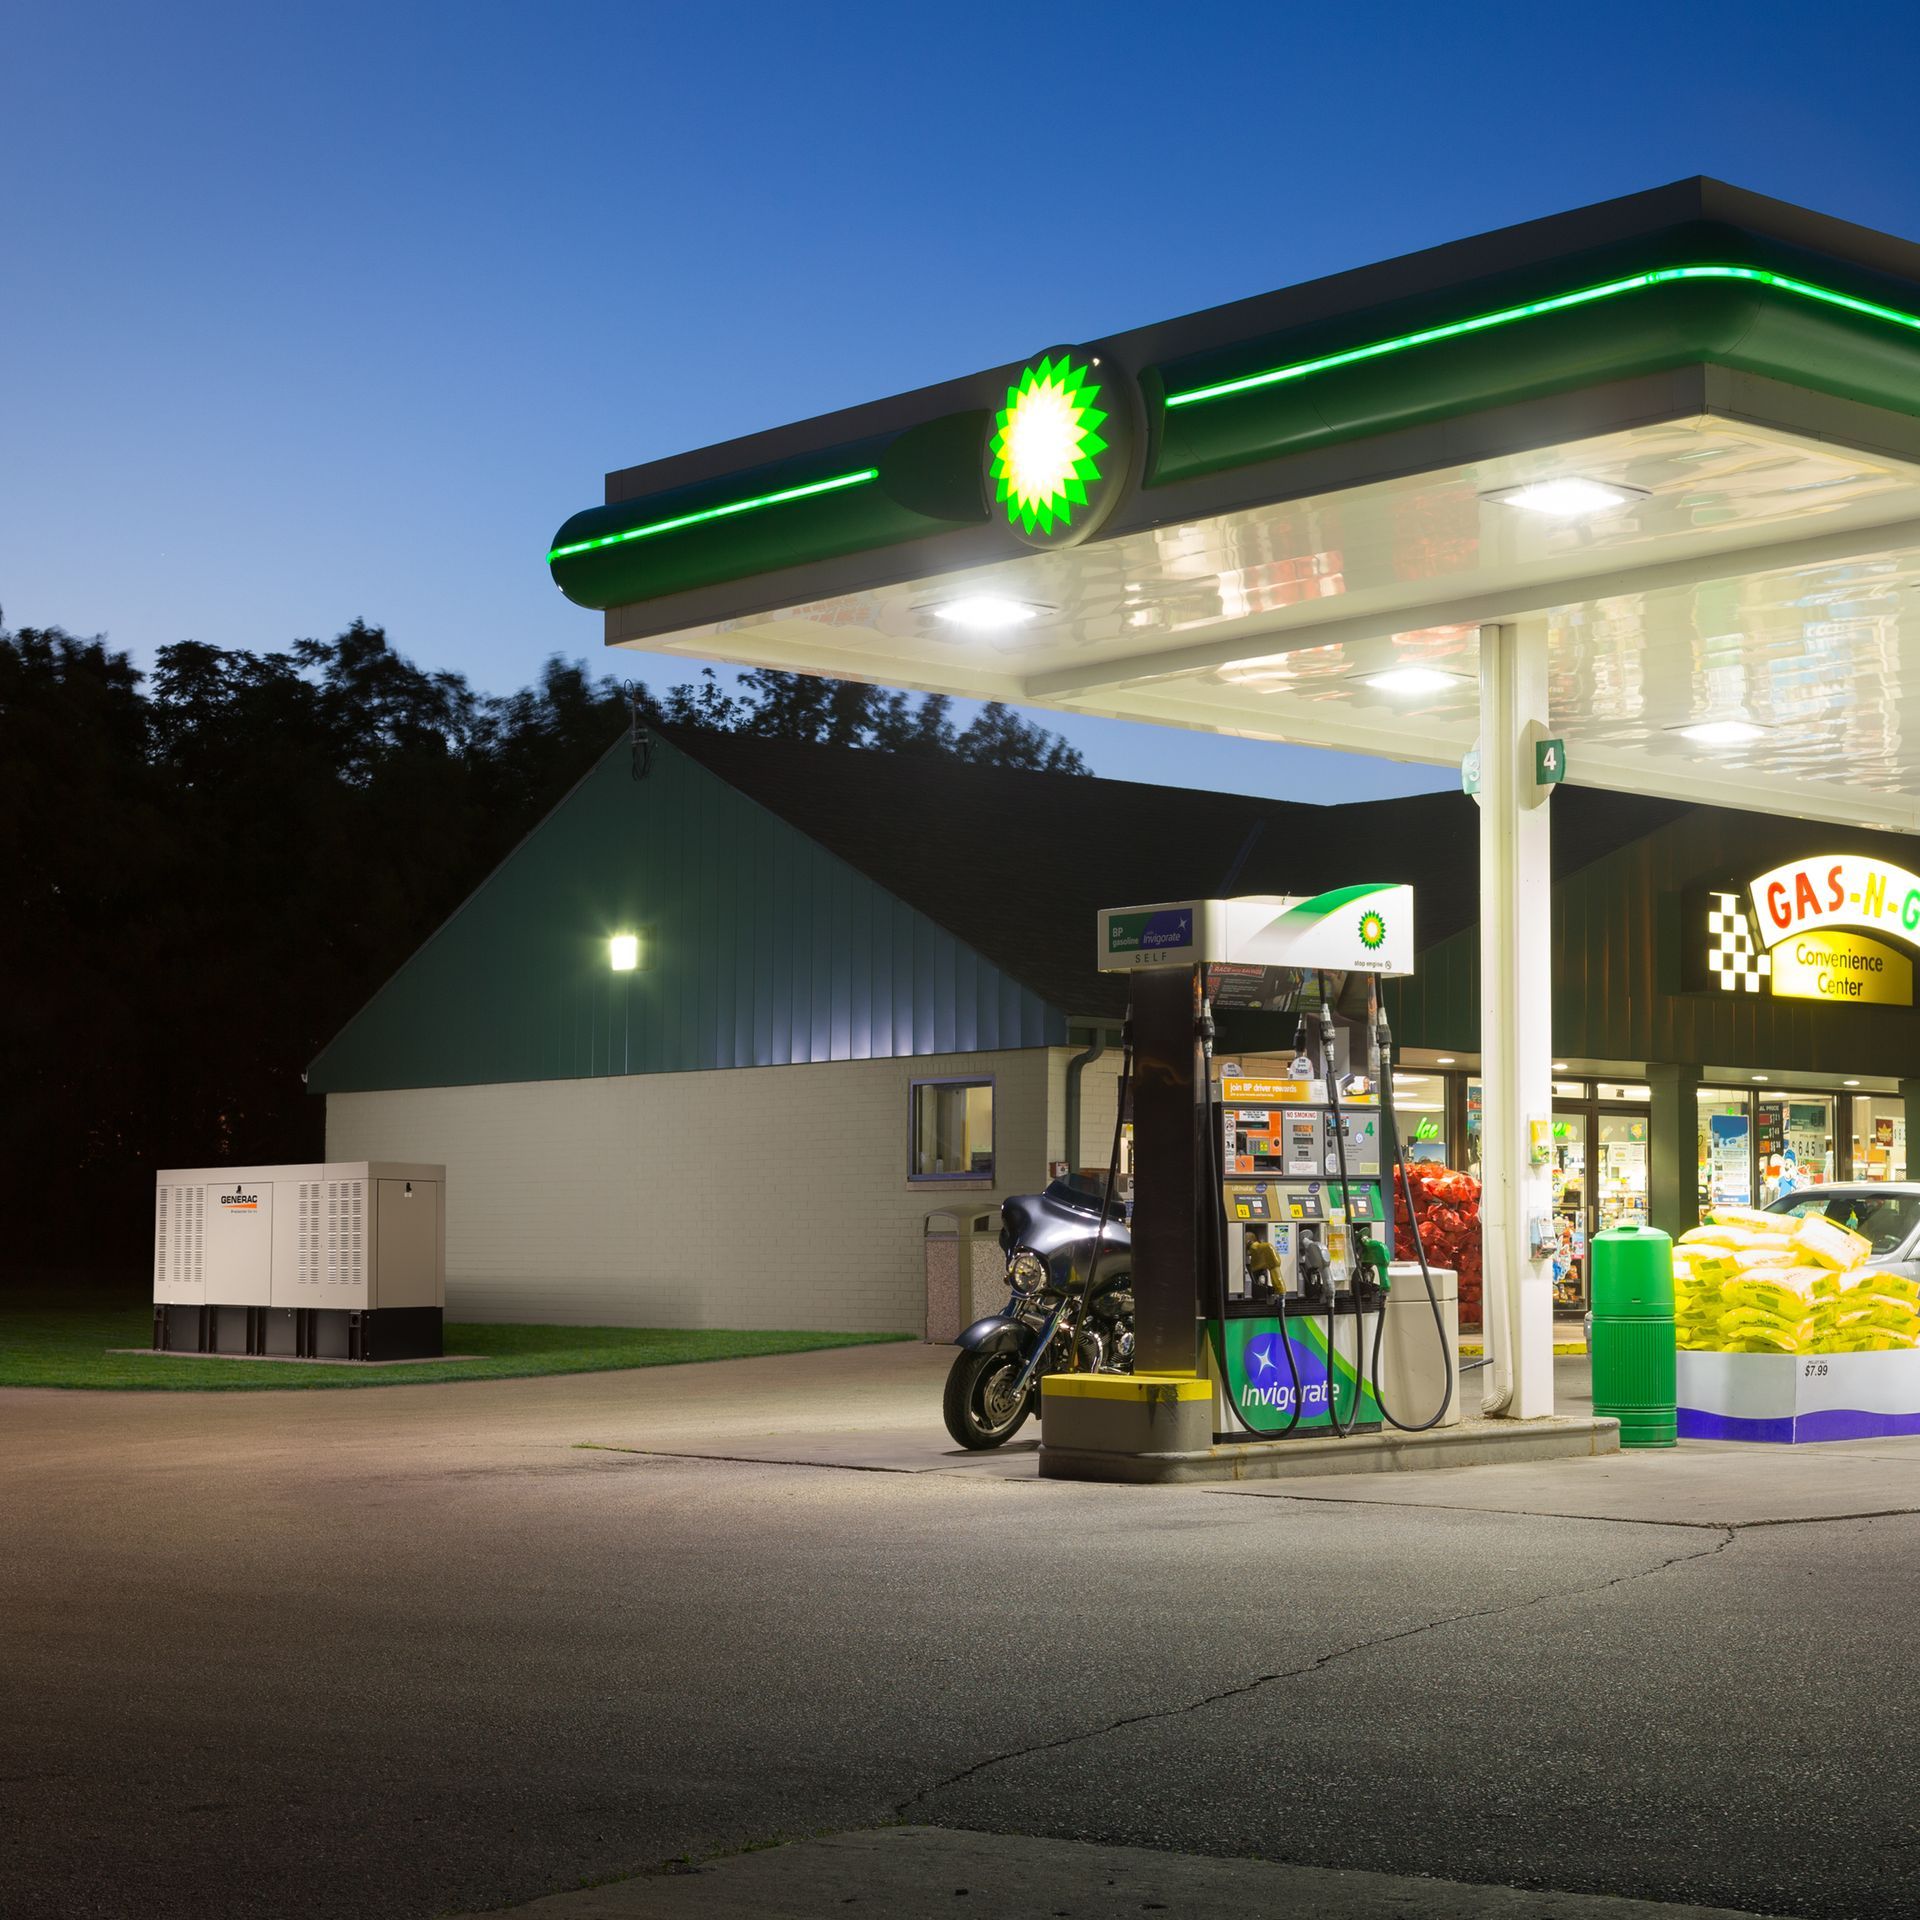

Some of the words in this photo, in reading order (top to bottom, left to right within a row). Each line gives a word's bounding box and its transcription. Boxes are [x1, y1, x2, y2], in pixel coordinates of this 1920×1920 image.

[1543, 747, 1557, 771] 4
[1112, 927, 1124, 938] BP
[1112, 936, 1139, 949] gasoline
[1135, 951, 1167, 964] SELF
[1796, 943, 1884, 973] Convenience
[1366, 961, 1383, 969] engine
[1817, 972, 1864, 997] Center
[1230, 1083, 1242, 1093] join
[1243, 1083, 1252, 1092] BP
[1254, 1084, 1271, 1093] driver
[1272, 1085, 1297, 1093] rewards
[1286, 1111, 1294, 1119] NO
[1294, 1111, 1317, 1119] SMOKING
[1364, 1121, 1375, 1137] 4
[1415, 1117, 1439, 1140] Ice
[221, 1195, 258, 1204] GENERAC
[1805, 1364, 1828, 1377] $7.99
